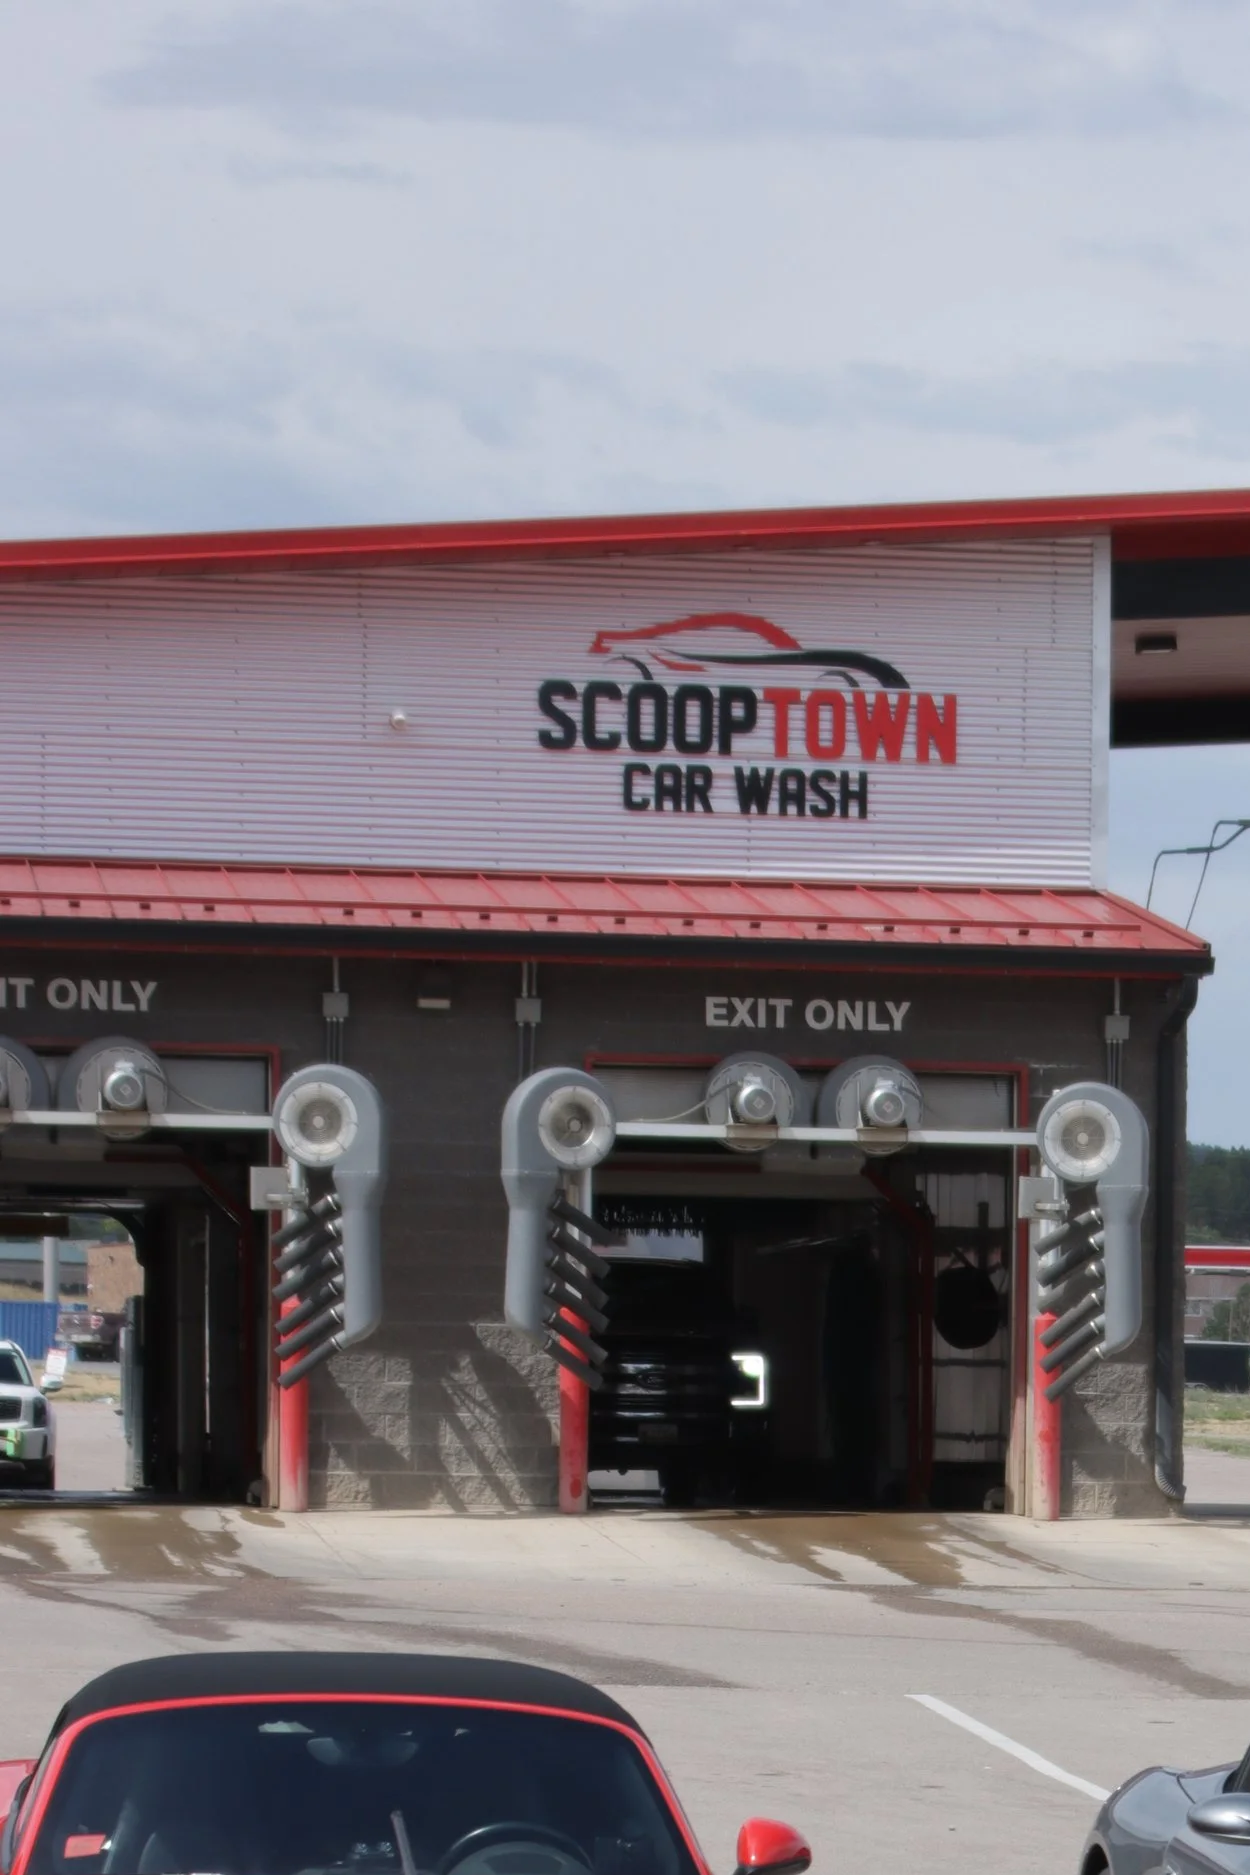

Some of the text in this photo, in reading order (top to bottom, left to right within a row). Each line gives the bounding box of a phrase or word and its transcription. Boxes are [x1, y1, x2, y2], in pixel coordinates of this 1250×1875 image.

[537, 679, 958, 765] SCOOPTOWN
[622, 762, 869, 820] CAR WASH
[47, 977, 158, 1012] ONLY
[705, 996, 912, 1032] EXIT ONLY
